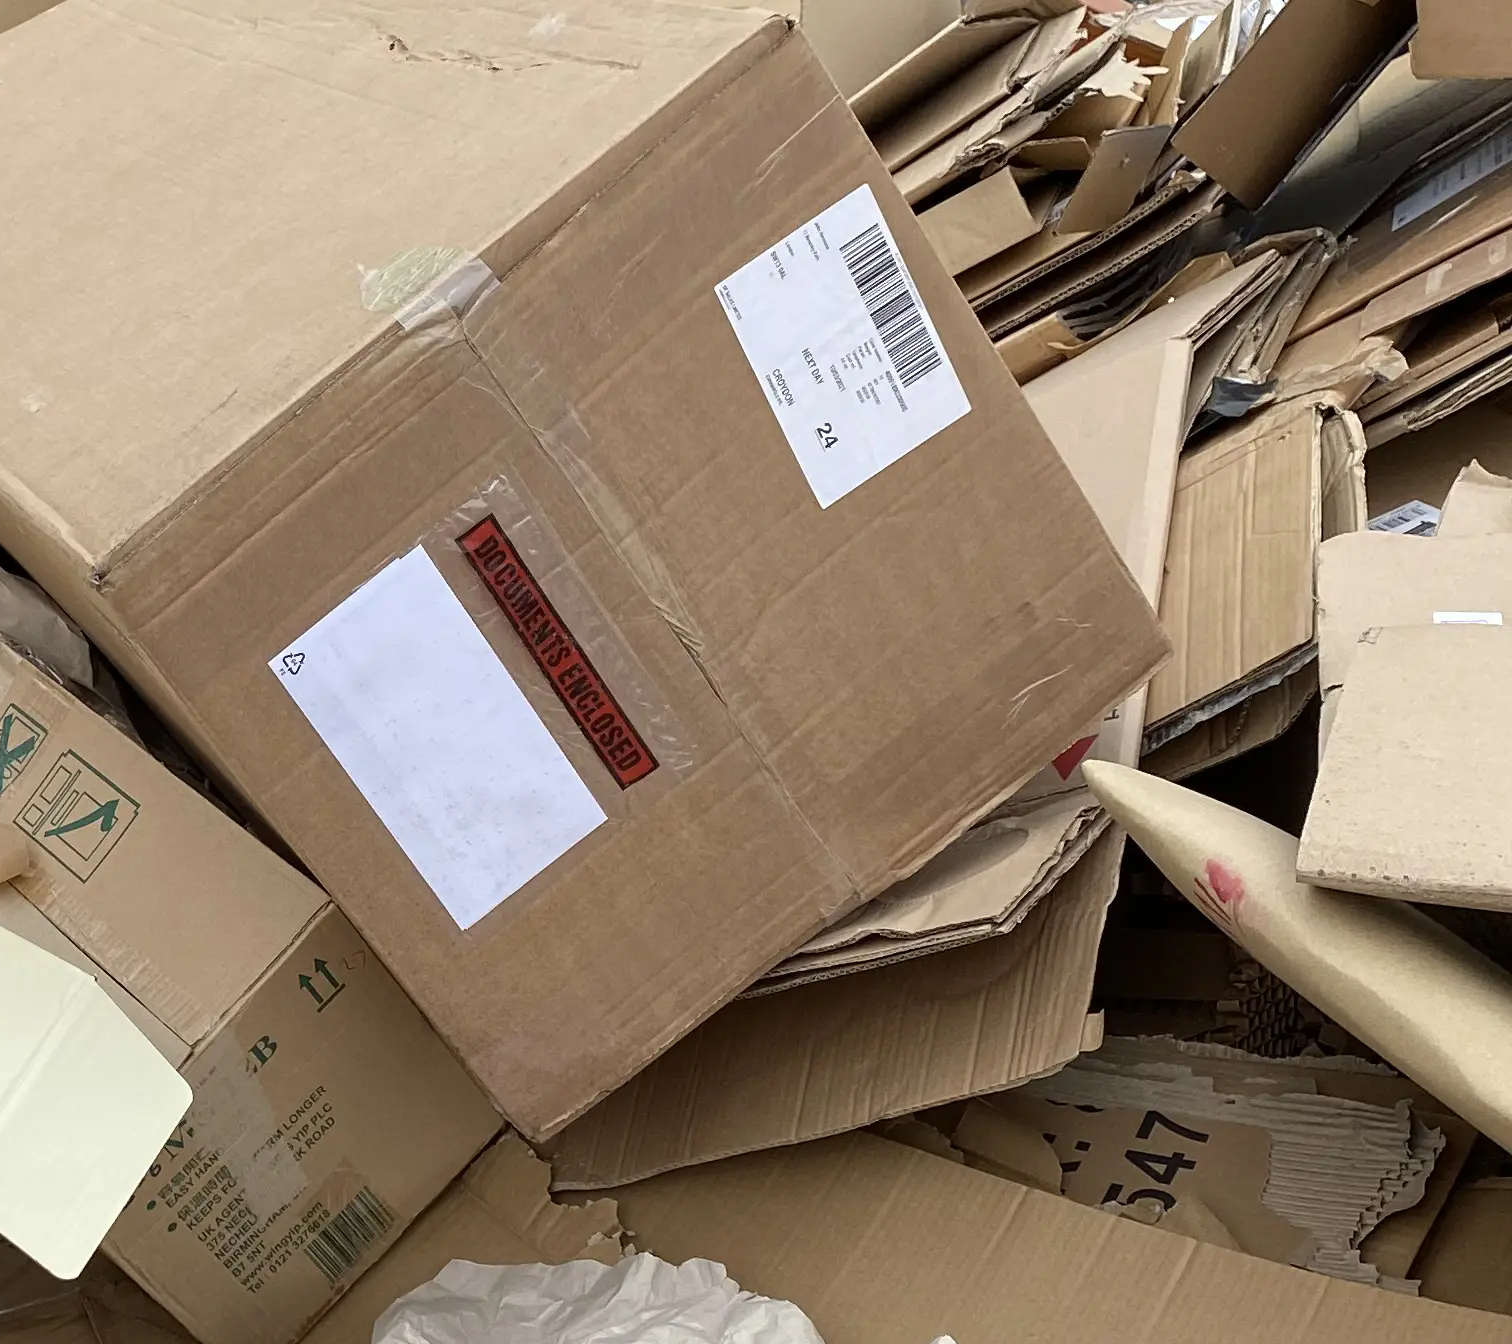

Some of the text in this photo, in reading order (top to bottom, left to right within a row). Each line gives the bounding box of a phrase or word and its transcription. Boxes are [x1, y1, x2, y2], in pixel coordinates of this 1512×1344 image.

[772, 368, 796, 407] CROYDON
[801, 347, 825, 385] NEXT DAY
[816, 422, 839, 449] 24
[473, 534, 642, 772] DOCUMENTS ENCLOSED
[186, 1194, 222, 1231] KEEPS
[282, 1085, 327, 1131] LONGER
[197, 1223, 216, 1243] UK
[292, 1124, 310, 1143] YIP
[310, 1102, 333, 1127] PLC
[206, 1231, 226, 1252] 375
[305, 1116, 336, 1151] ROAD
[165, 1176, 194, 1208] EASY
[240, 1201, 323, 1286] www.wingyip.com
[247, 1277, 265, 1294] Tel
[268, 1248, 293, 1274] 0121
